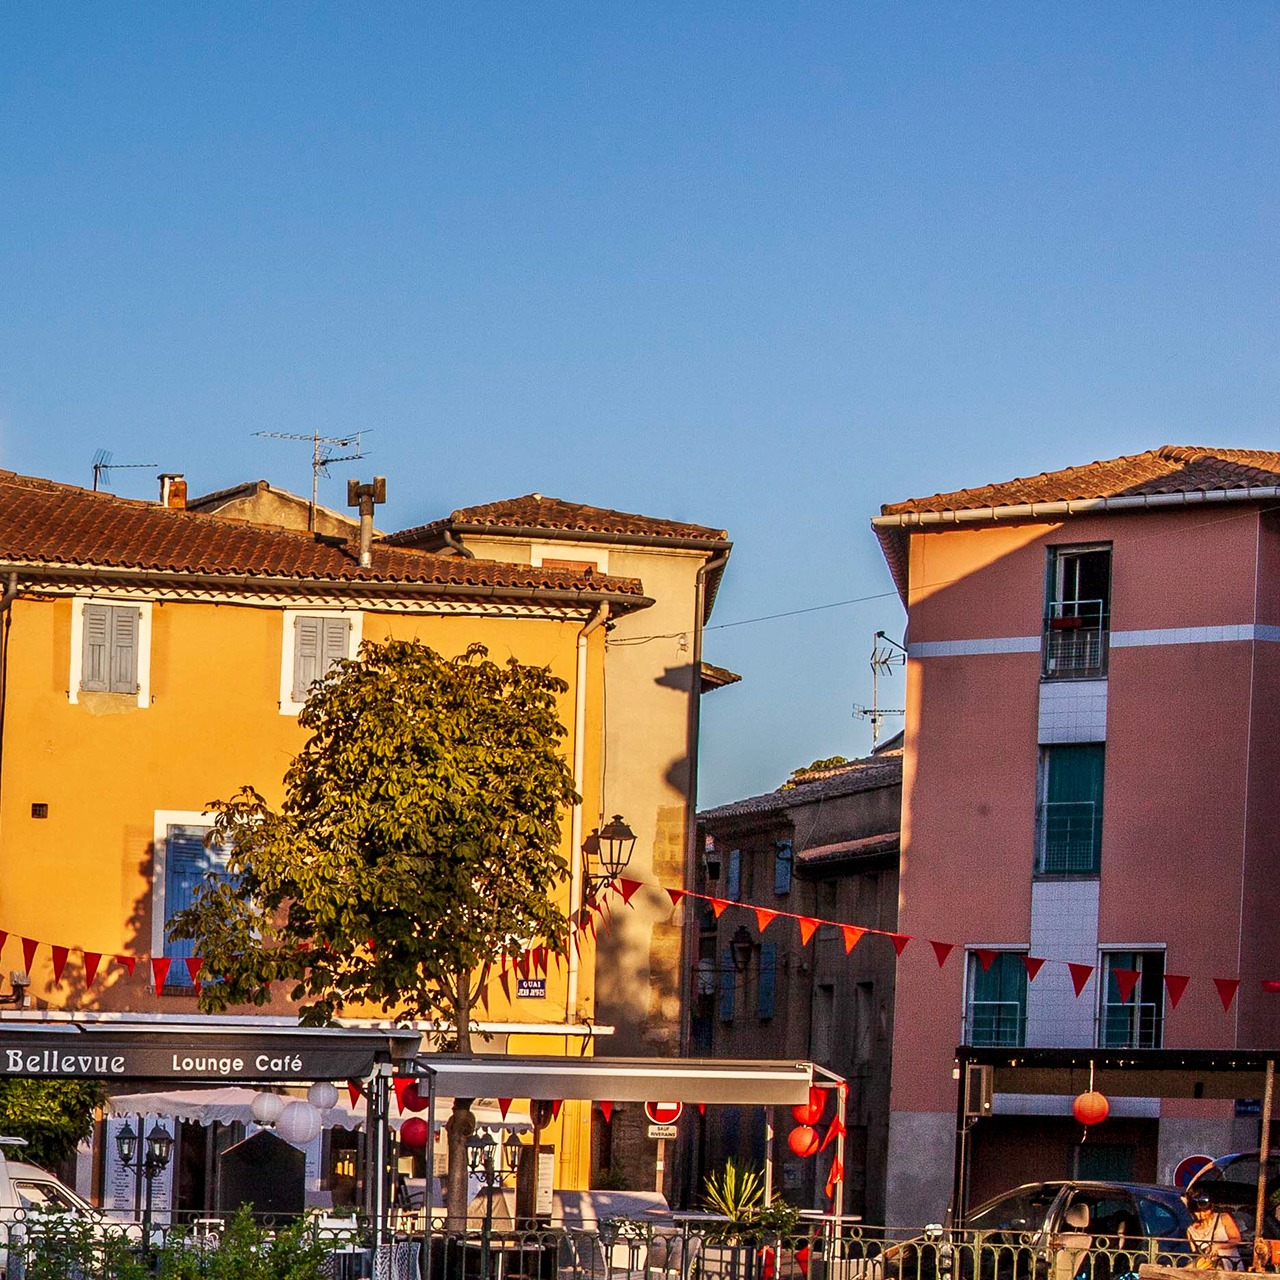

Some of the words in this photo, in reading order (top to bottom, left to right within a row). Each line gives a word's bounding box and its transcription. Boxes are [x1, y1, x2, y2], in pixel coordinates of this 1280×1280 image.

[6, 1049, 126, 1073] Bellevue
[172, 1054, 244, 1075] Lounge
[255, 1054, 303, 1071] Café
